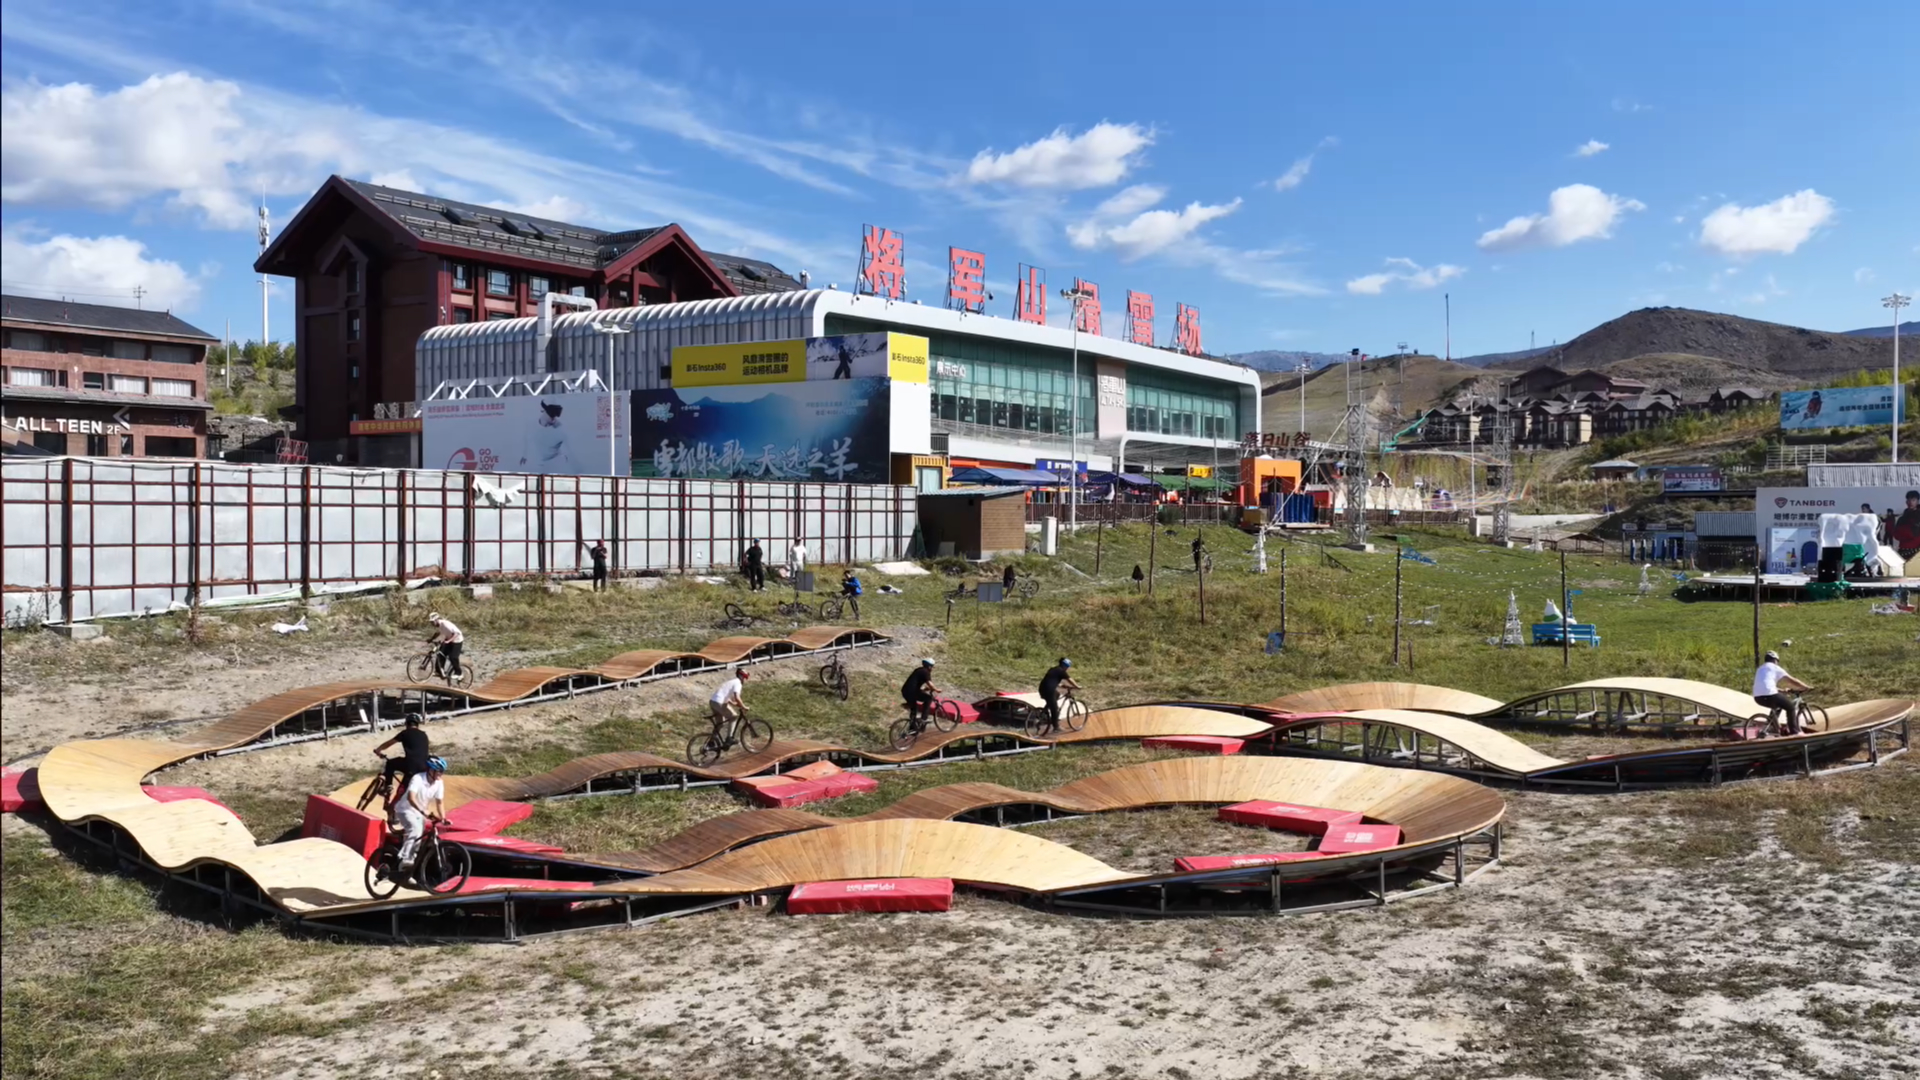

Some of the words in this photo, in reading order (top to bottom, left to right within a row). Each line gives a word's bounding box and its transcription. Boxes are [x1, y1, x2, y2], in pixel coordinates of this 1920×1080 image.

[742, 364, 789, 376] 运动相机品牌
[15, 416, 52, 432] ALL
[56, 418, 103, 434] TEEN
[478, 448, 491, 456] GO
[479, 455, 499, 463] LOVE
[478, 463, 495, 471] JOY
[1790, 499, 1836, 507] TANBOER
